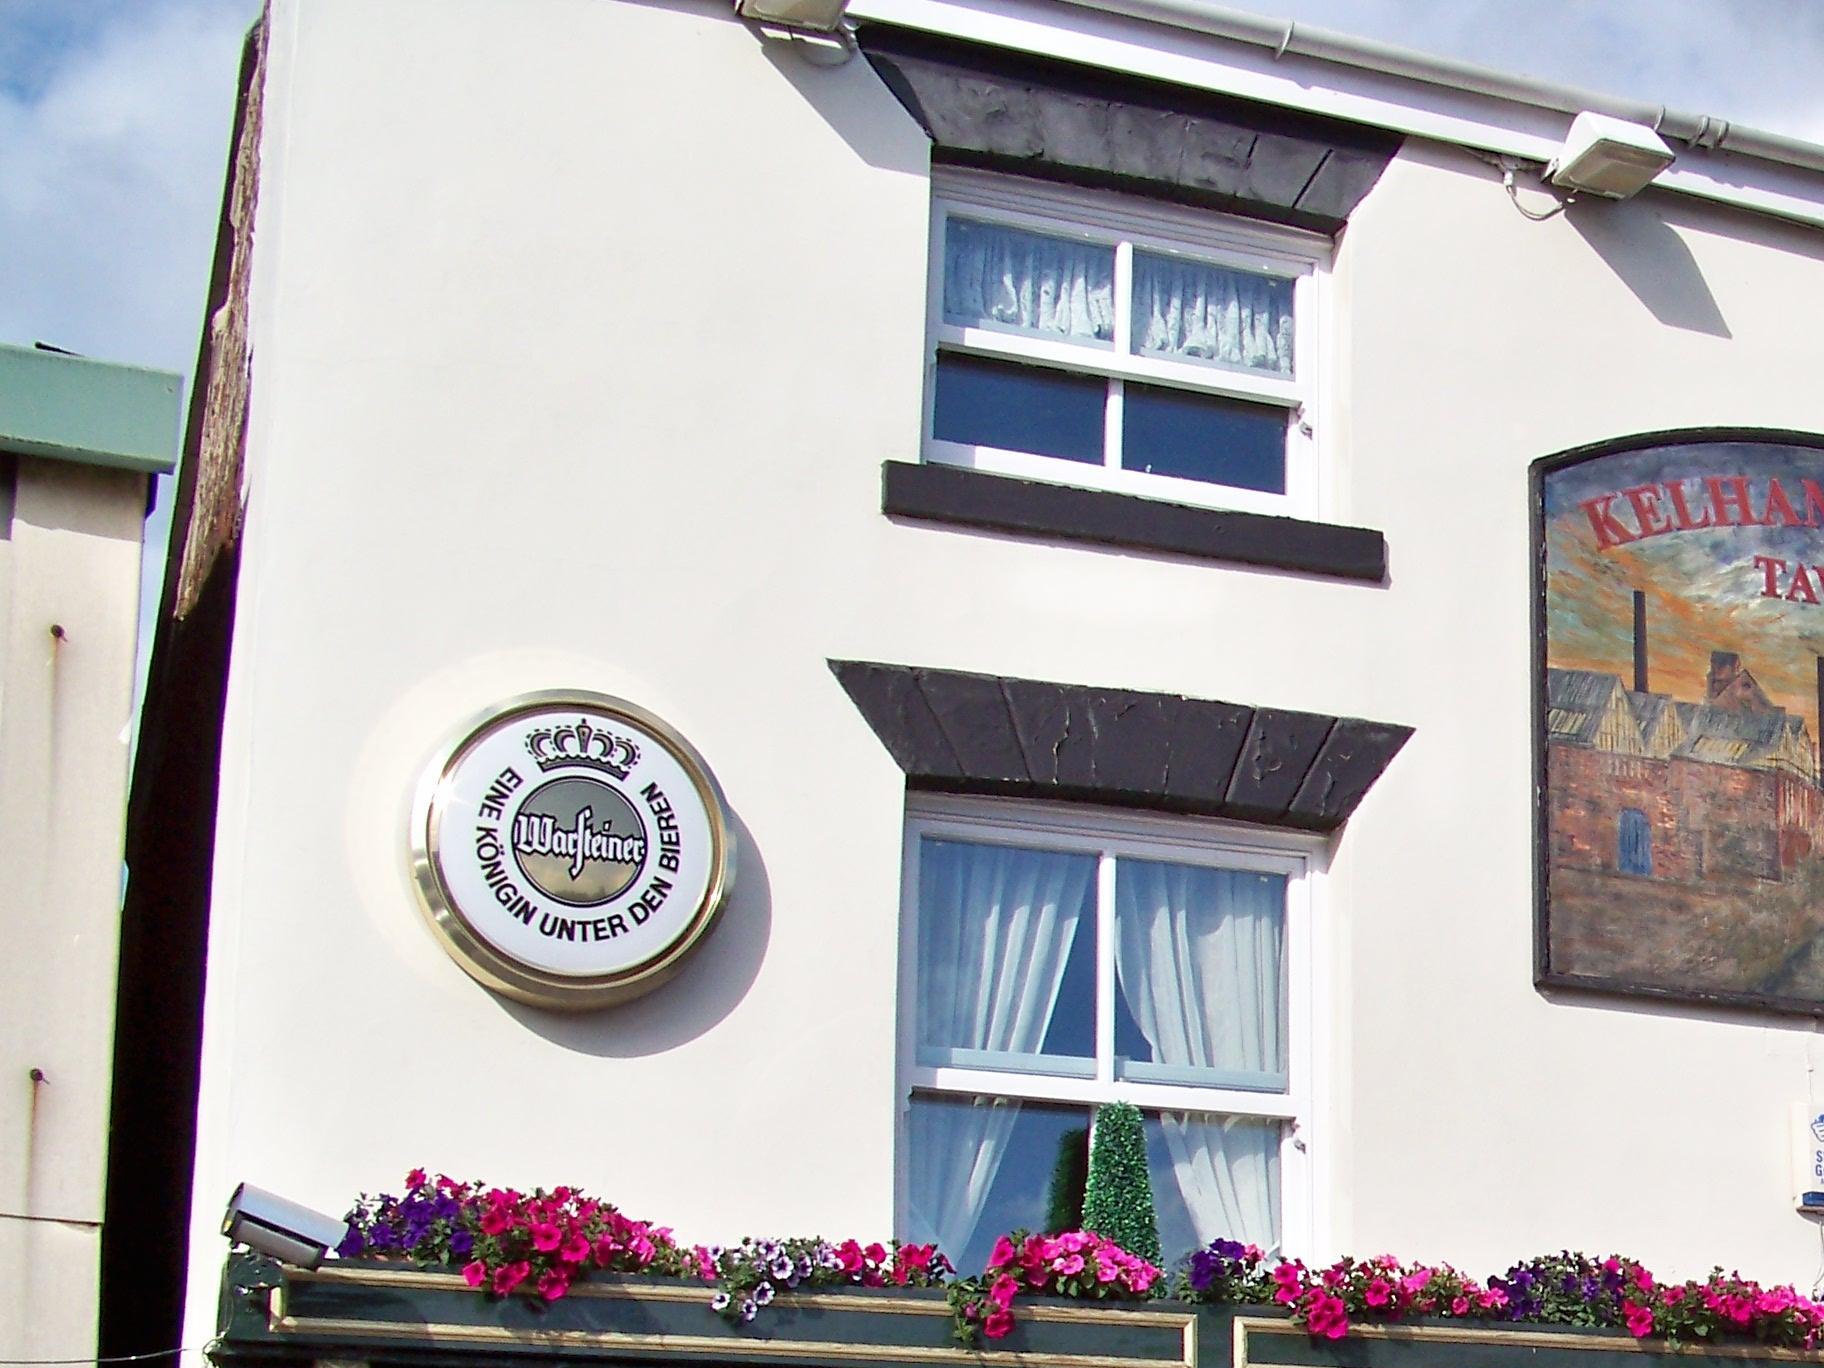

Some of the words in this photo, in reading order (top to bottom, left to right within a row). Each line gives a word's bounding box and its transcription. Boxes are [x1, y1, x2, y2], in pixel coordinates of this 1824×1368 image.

[477, 766, 525, 823] EINE
[639, 781, 682, 874] BIEREN
[475, 824, 538, 926] KÖNIGIN
[627, 875, 674, 927] DEN
[538, 912, 631, 943] UNTER
